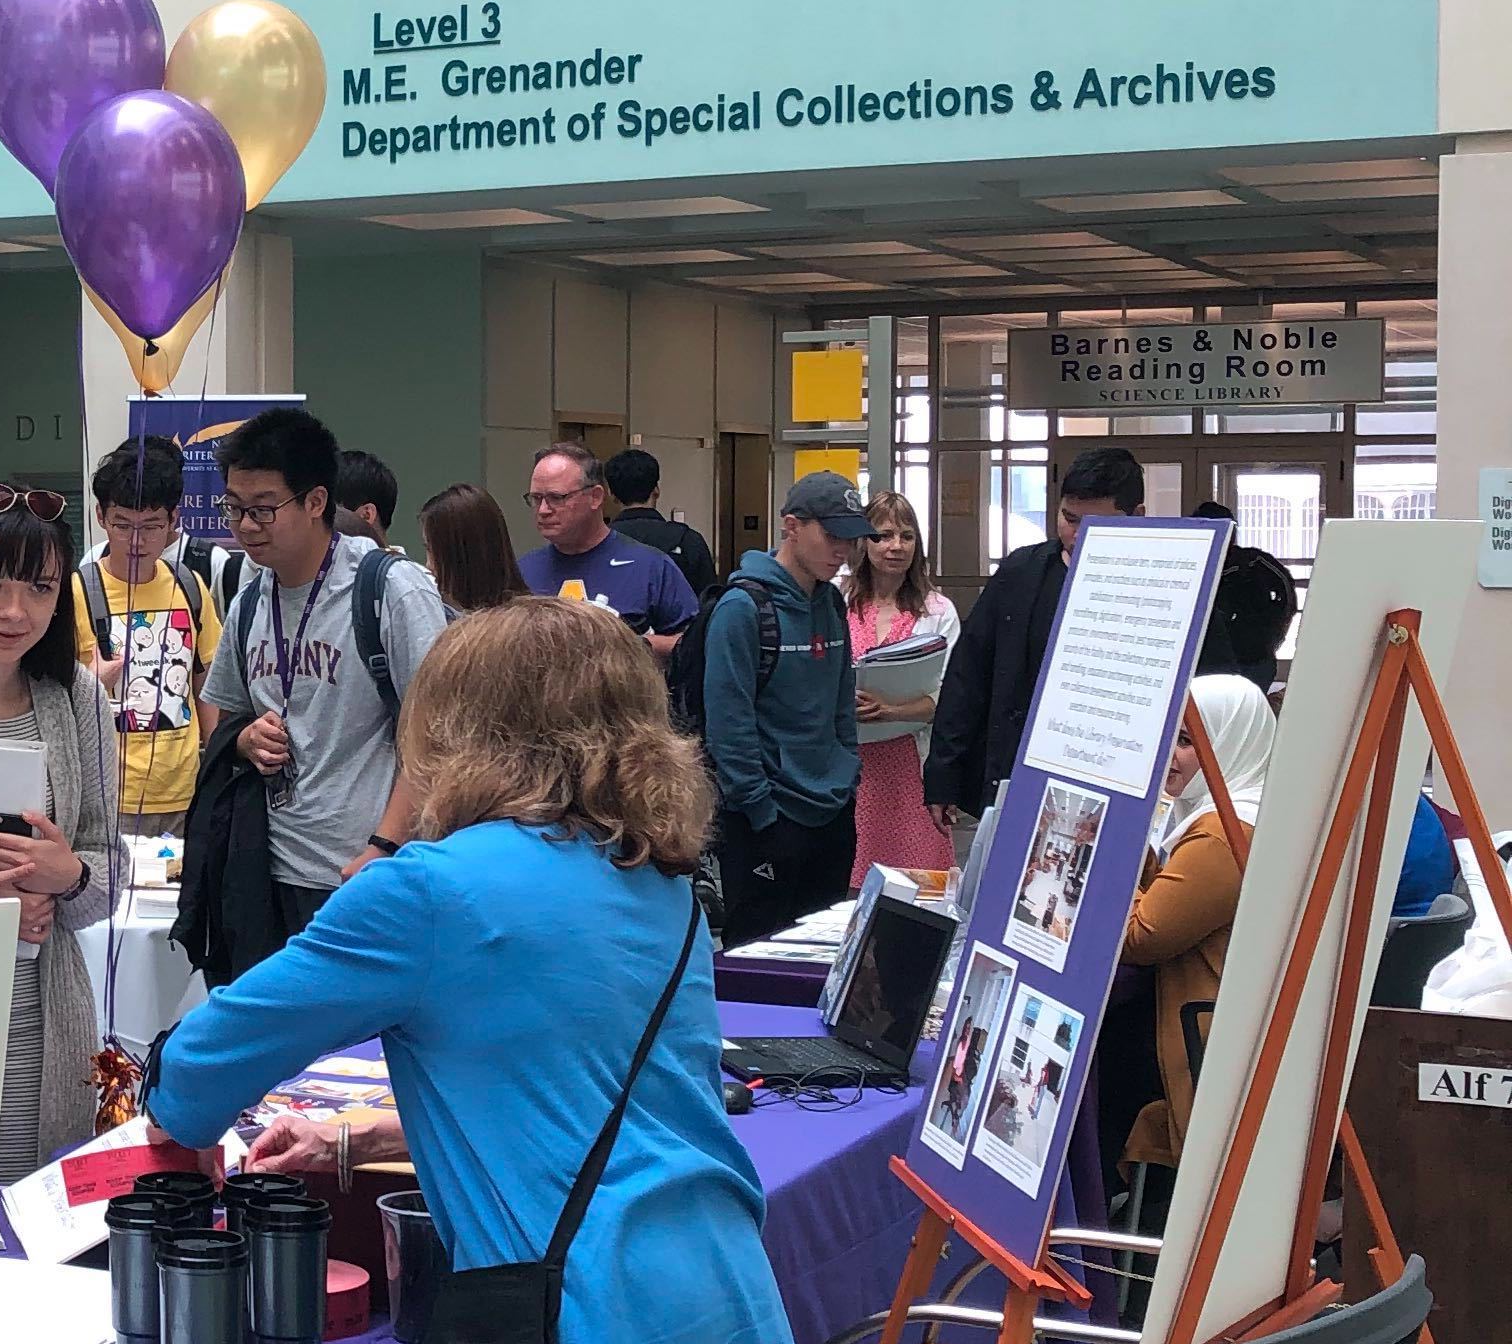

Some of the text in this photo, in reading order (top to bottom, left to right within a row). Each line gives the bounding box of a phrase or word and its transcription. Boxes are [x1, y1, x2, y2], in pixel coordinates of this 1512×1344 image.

[373, 1, 502, 53] Level 3
[342, 47, 644, 107] M.E. Grenander
[342, 61, 1276, 165] Department of Special Collections & Archives
[1050, 325, 1339, 357] Barnes & Noble
[1060, 355, 1328, 385] Reading Room
[1098, 386, 1286, 402] SCIENCE LIBRARY
[182, 450, 216, 461] RITER
[1492, 527, 1512, 540] Dig
[1492, 540, 1512, 551] Wo
[1429, 1068, 1493, 1102] Alf
